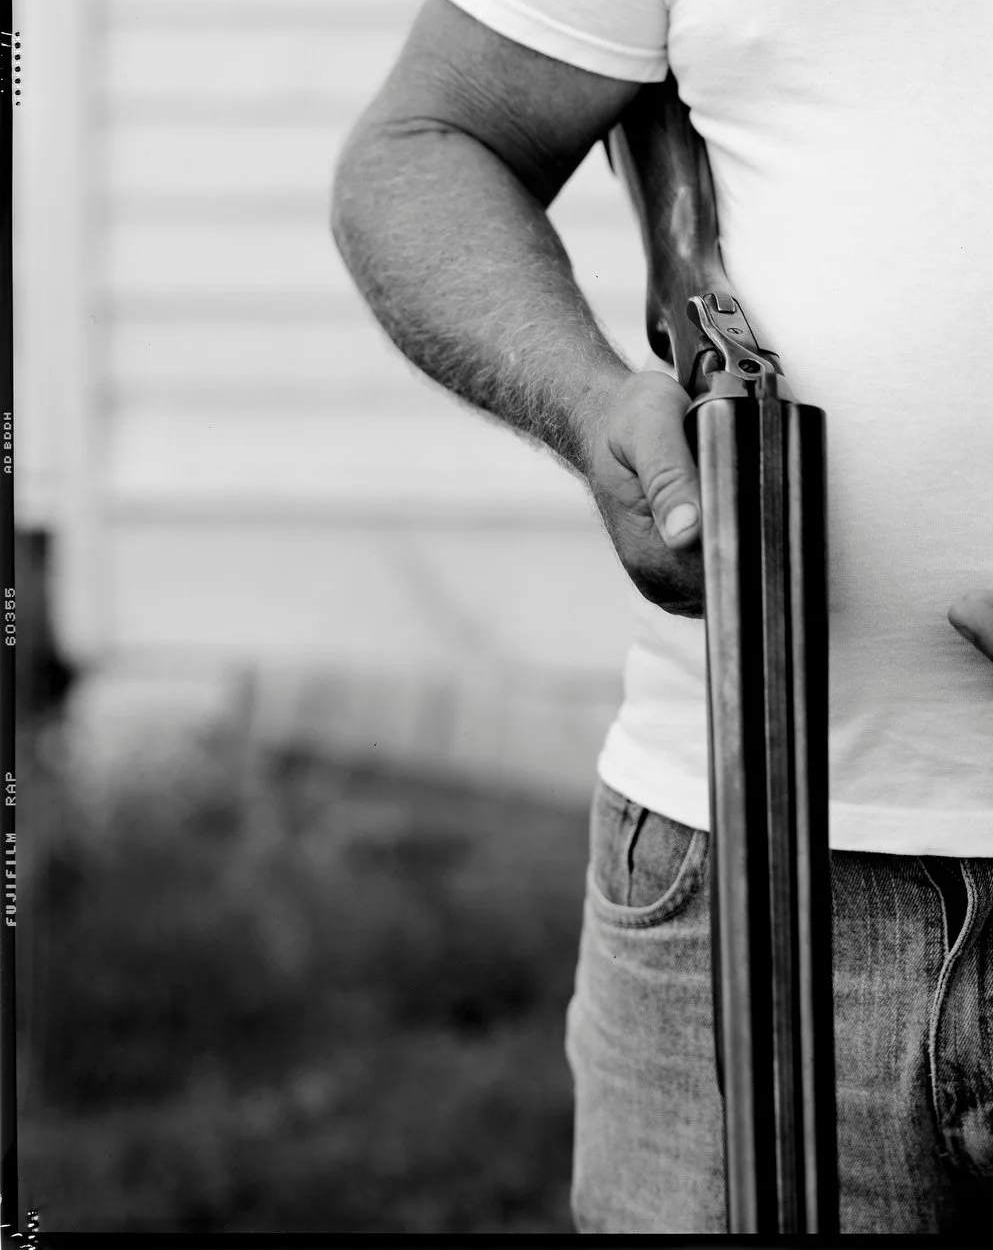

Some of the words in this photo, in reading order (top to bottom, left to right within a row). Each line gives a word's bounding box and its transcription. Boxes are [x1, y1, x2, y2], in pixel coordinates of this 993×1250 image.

[5, 587, 16, 646] 60355
[5, 771, 16, 806] RAP
[5, 832, 16, 927] FUJIFILM
